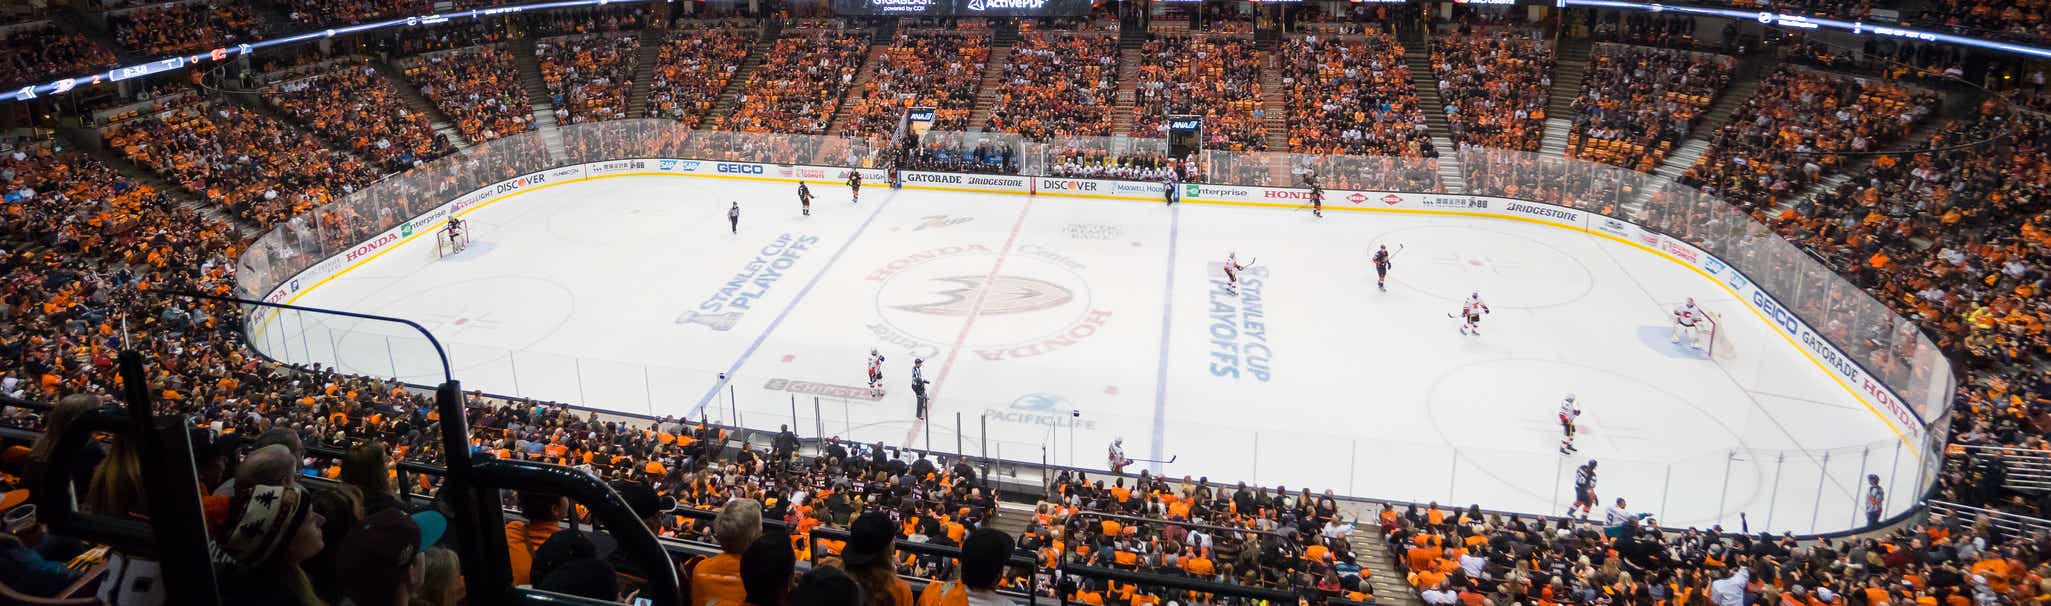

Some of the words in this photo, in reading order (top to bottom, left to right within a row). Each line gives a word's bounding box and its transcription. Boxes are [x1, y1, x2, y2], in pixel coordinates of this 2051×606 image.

[497, 173, 545, 194] DISCOVER
[717, 163, 764, 175] GEICO
[907, 173, 962, 184] GATORADE
[967, 177, 1023, 188] BRIDGESTONE
[1043, 179, 1097, 192] DISCOVER
[1506, 202, 1577, 222] BRIDGESTONE
[346, 232, 398, 263] HONDA
[865, 243, 993, 281] HONDA
[701, 255, 768, 312] STANLEY
[760, 233, 793, 257] CUP
[729, 234, 820, 310] PLAYOFFS
[1239, 277, 1267, 342] STANLEY
[1753, 289, 1798, 336] GEICO
[975, 309, 1113, 361] HONDA
[1243, 342, 1272, 383] CUP
[1802, 331, 1859, 384] GATORADE
[986, 407, 1049, 427] PACIFIC
[1056, 415, 1097, 431] LIFE
[1862, 378, 1918, 438] HONDA
